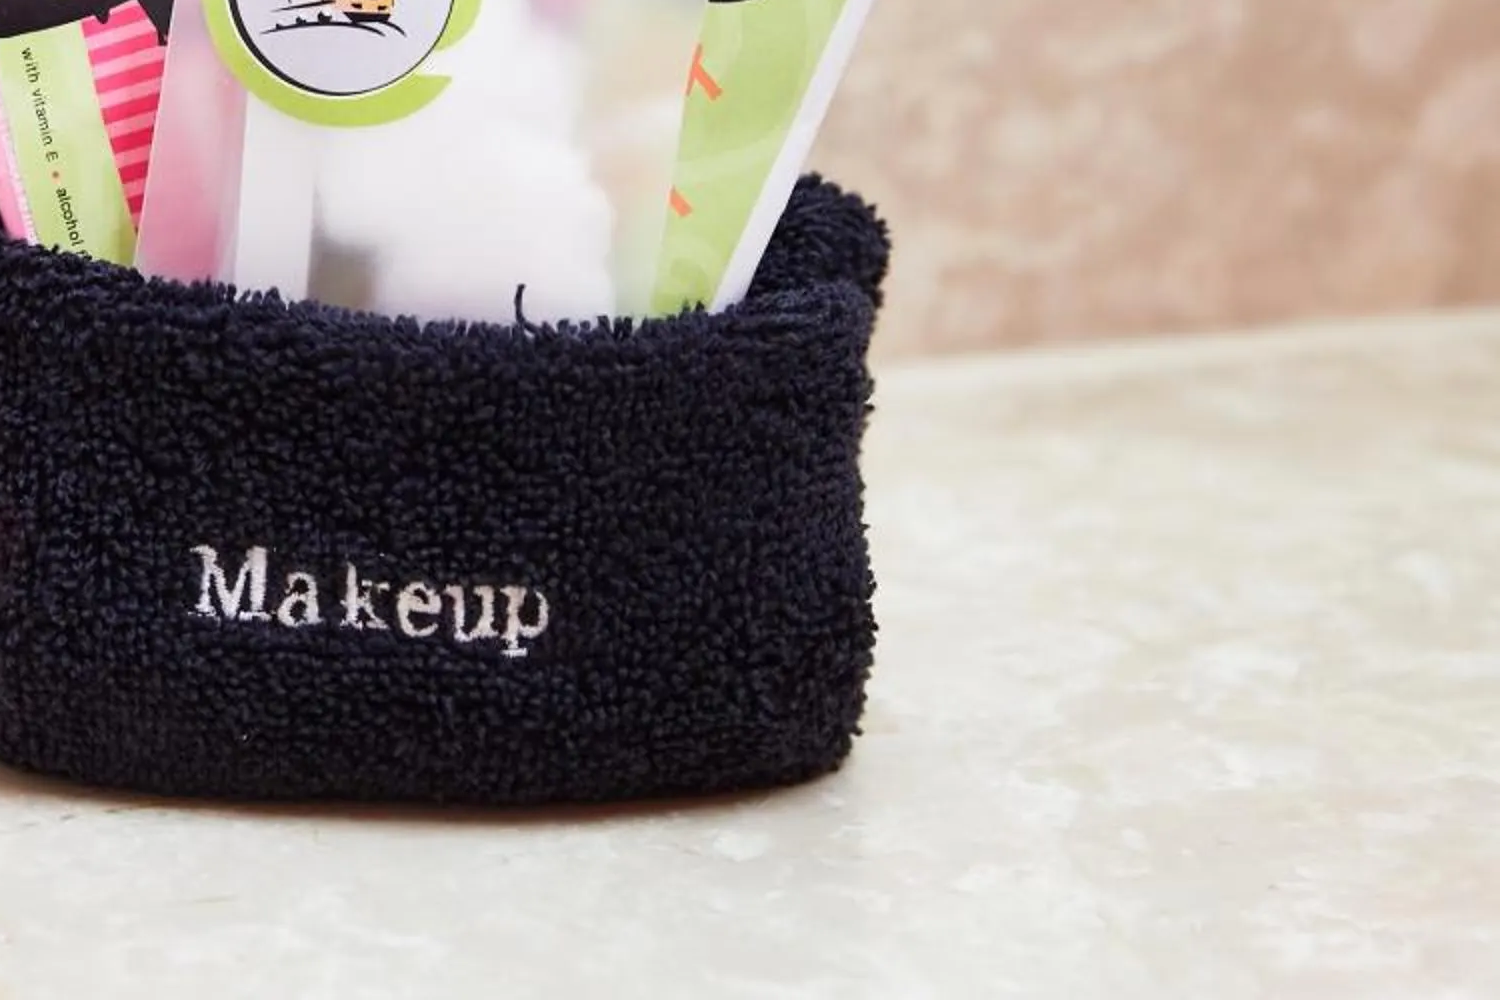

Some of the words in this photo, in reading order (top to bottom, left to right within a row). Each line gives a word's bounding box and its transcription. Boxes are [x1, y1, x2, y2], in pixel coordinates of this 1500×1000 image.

[21, 47, 41, 84] with
[32, 88, 55, 145] vitamin
[45, 150, 60, 164] E
[55, 188, 85, 248] alcohol
[187, 544, 550, 658] Makeup
